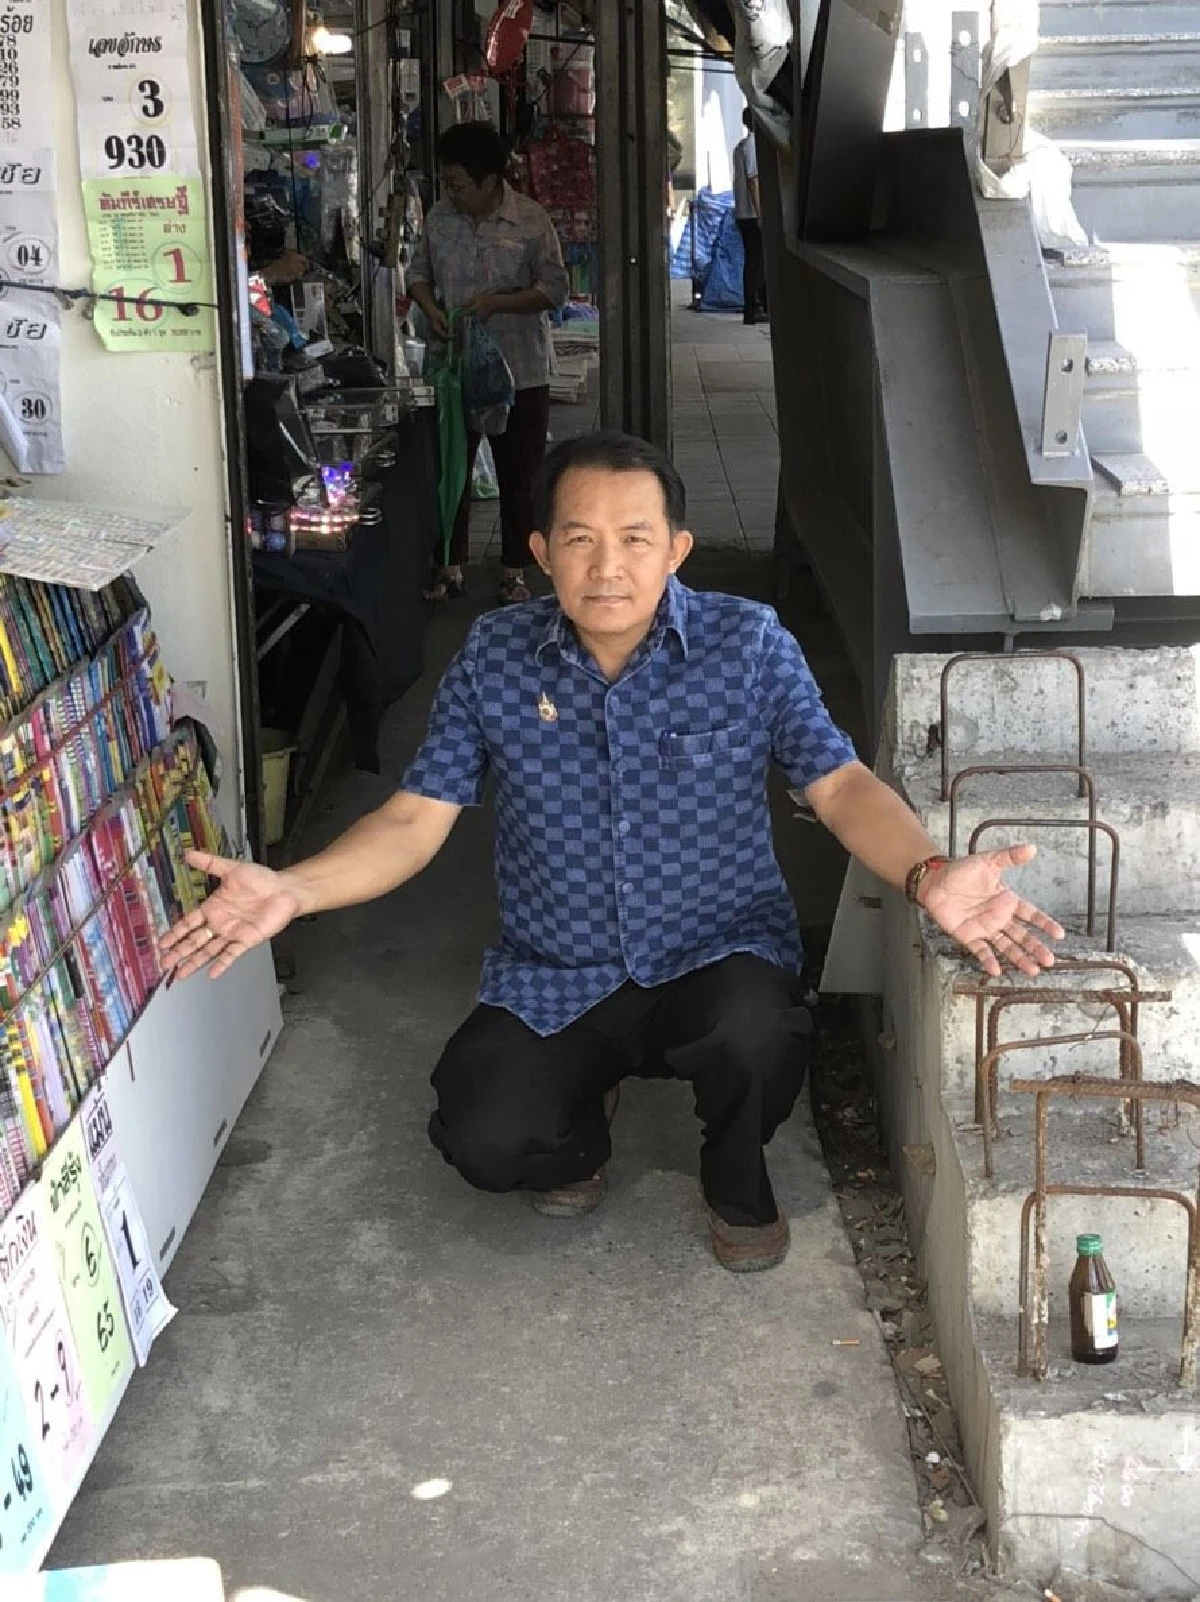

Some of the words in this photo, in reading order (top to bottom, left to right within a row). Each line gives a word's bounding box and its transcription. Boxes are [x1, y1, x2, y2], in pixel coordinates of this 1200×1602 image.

[138, 79, 165, 118] 3
[104, 134, 167, 170] 930
[17, 244, 44, 267] 04
[163, 248, 194, 283] 1
[108, 286, 164, 323] 16
[21, 398, 47, 420] 30
[84, 1235, 98, 1278] 6
[120, 1210, 141, 1270] 1
[96, 1296, 114, 1353] 65
